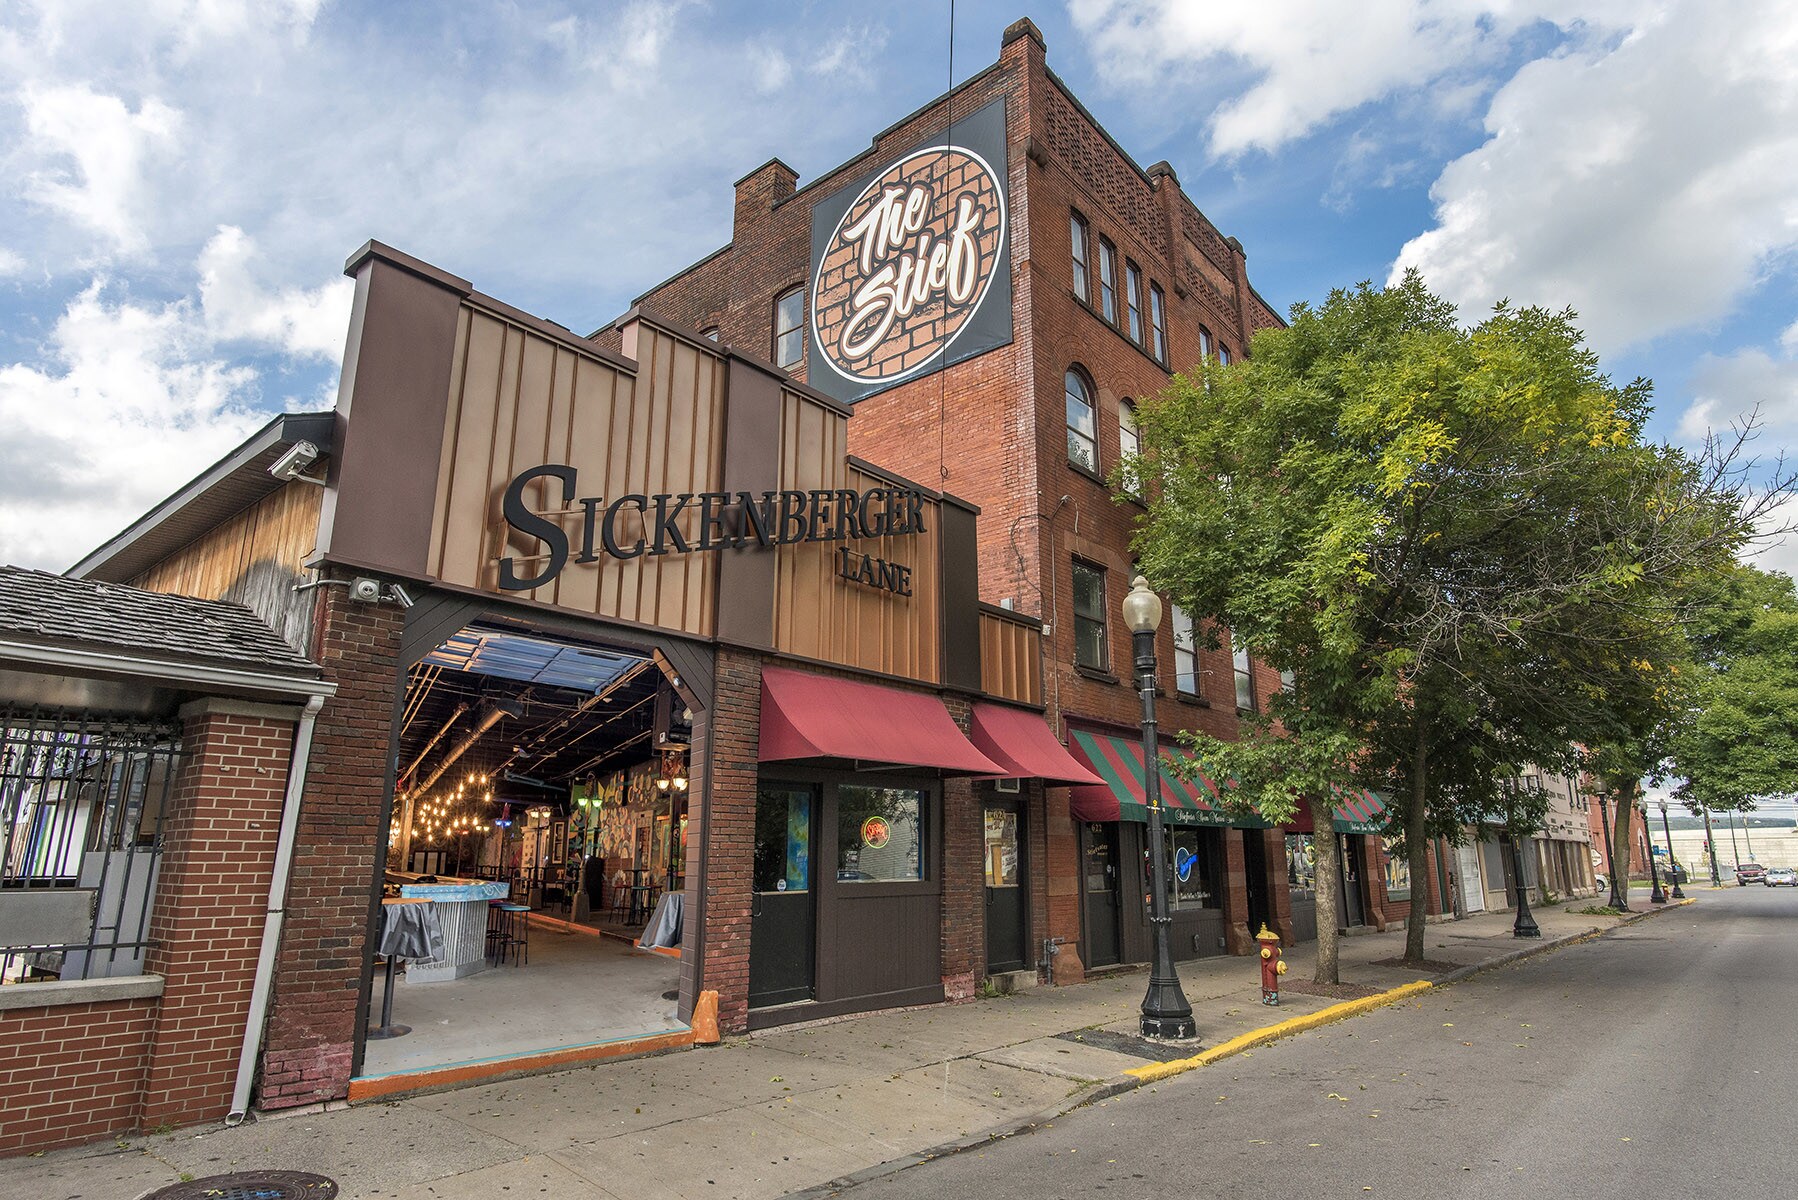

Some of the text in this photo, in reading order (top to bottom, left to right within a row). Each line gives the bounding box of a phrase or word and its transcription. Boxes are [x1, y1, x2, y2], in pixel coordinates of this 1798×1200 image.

[841, 186, 931, 274] The
[841, 197, 981, 358] Stief
[499, 463, 928, 591] SICKENBERGER
[839, 546, 912, 597] LANE
[1091, 823, 1102, 832] 622
